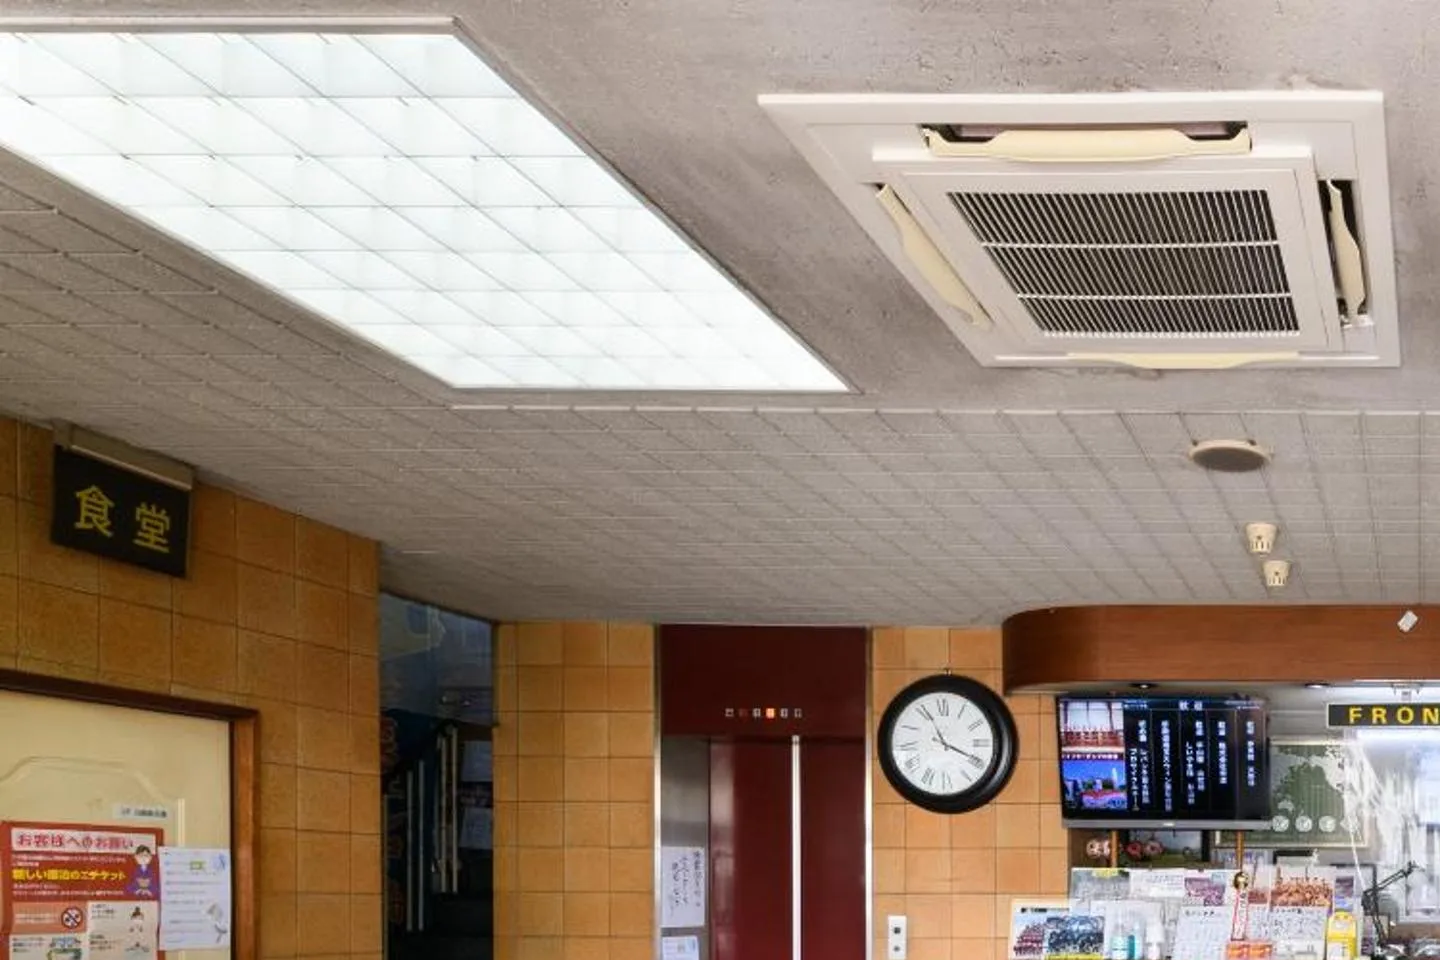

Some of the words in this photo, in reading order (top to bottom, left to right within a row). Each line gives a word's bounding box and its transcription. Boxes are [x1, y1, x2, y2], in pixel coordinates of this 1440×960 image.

[74, 485, 171, 553] 食堂
[16, 832, 135, 850] お客様へのお願い
